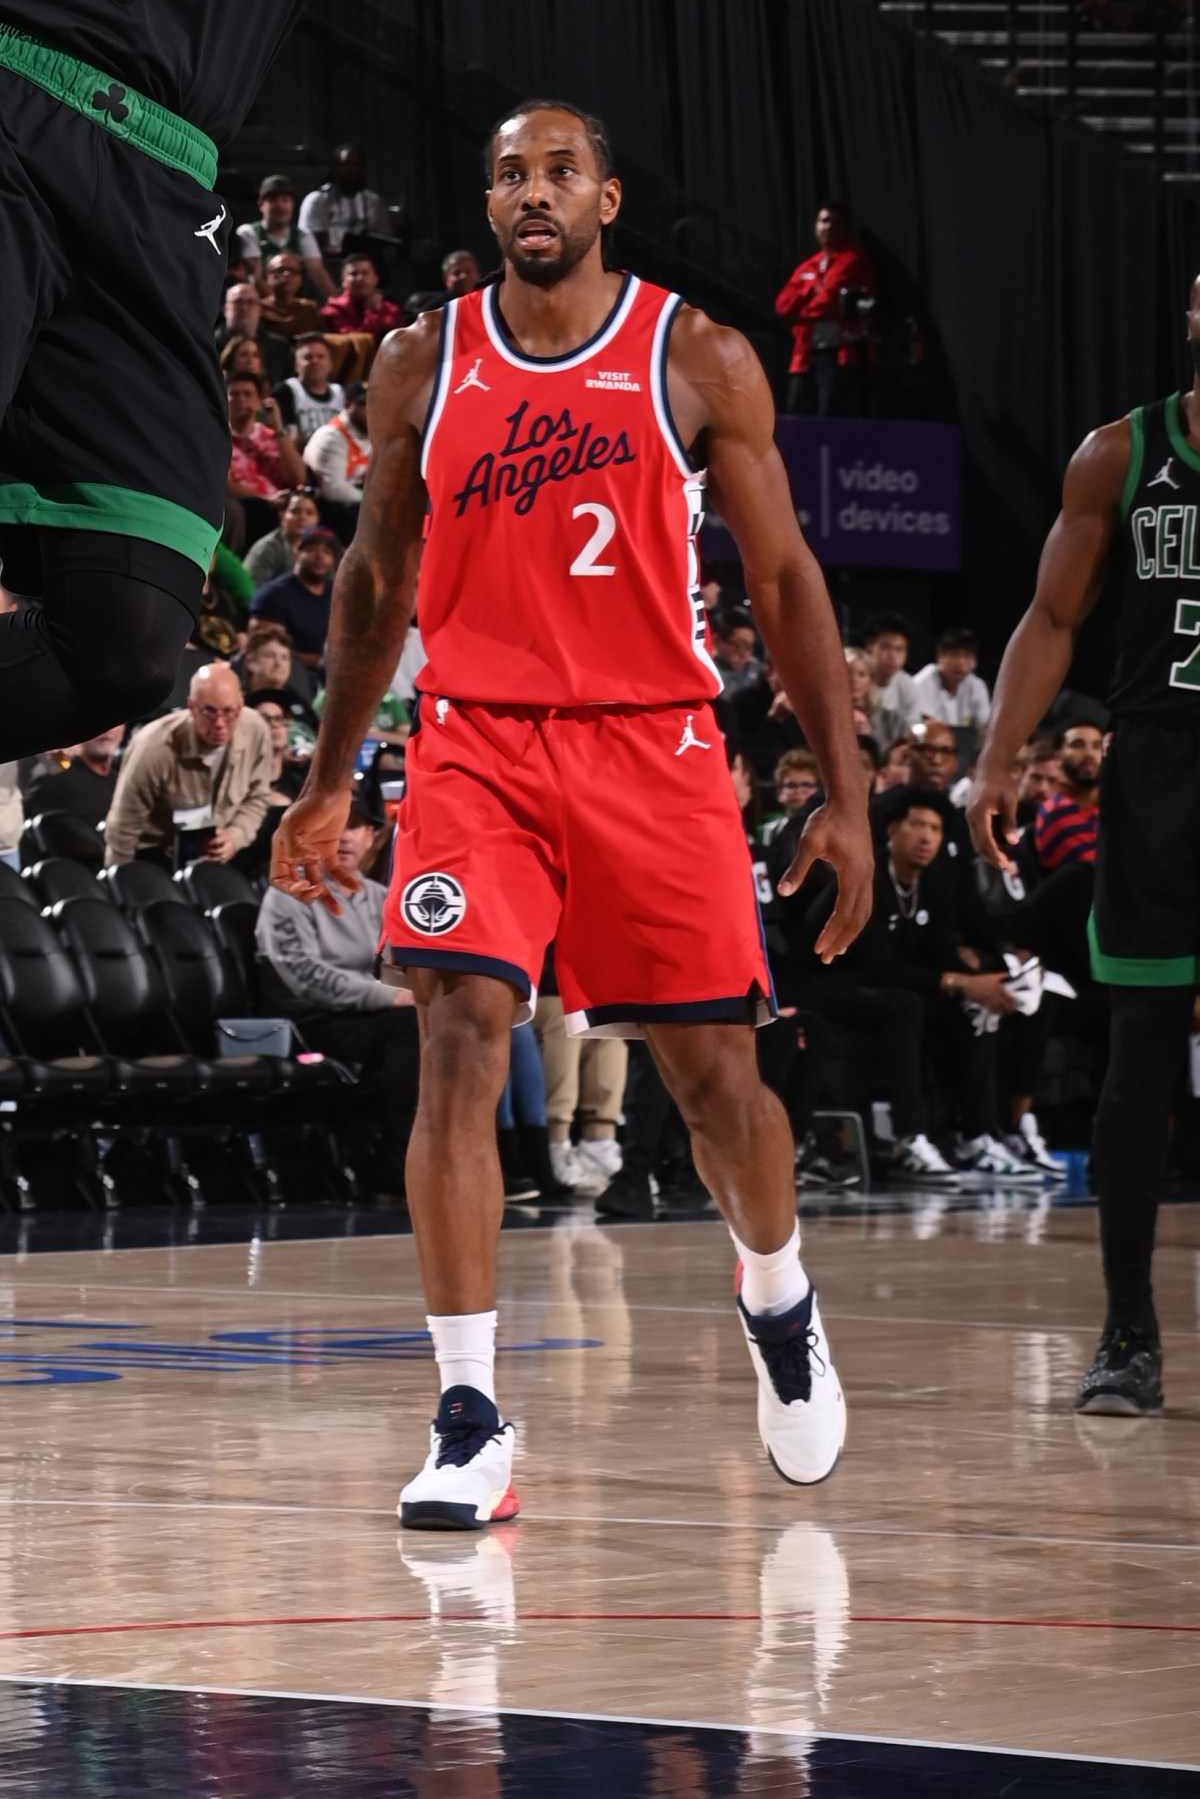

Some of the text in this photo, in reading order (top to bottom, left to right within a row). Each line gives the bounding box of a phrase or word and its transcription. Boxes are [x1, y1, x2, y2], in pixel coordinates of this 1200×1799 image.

[585, 379, 641, 393] RWANDA
[597, 371, 630, 382] VISIT
[500, 400, 578, 457] Los
[452, 422, 637, 519] Angeles
[837, 460, 919, 494] video
[837, 501, 951, 536] devices
[569, 501, 617, 577] 2
